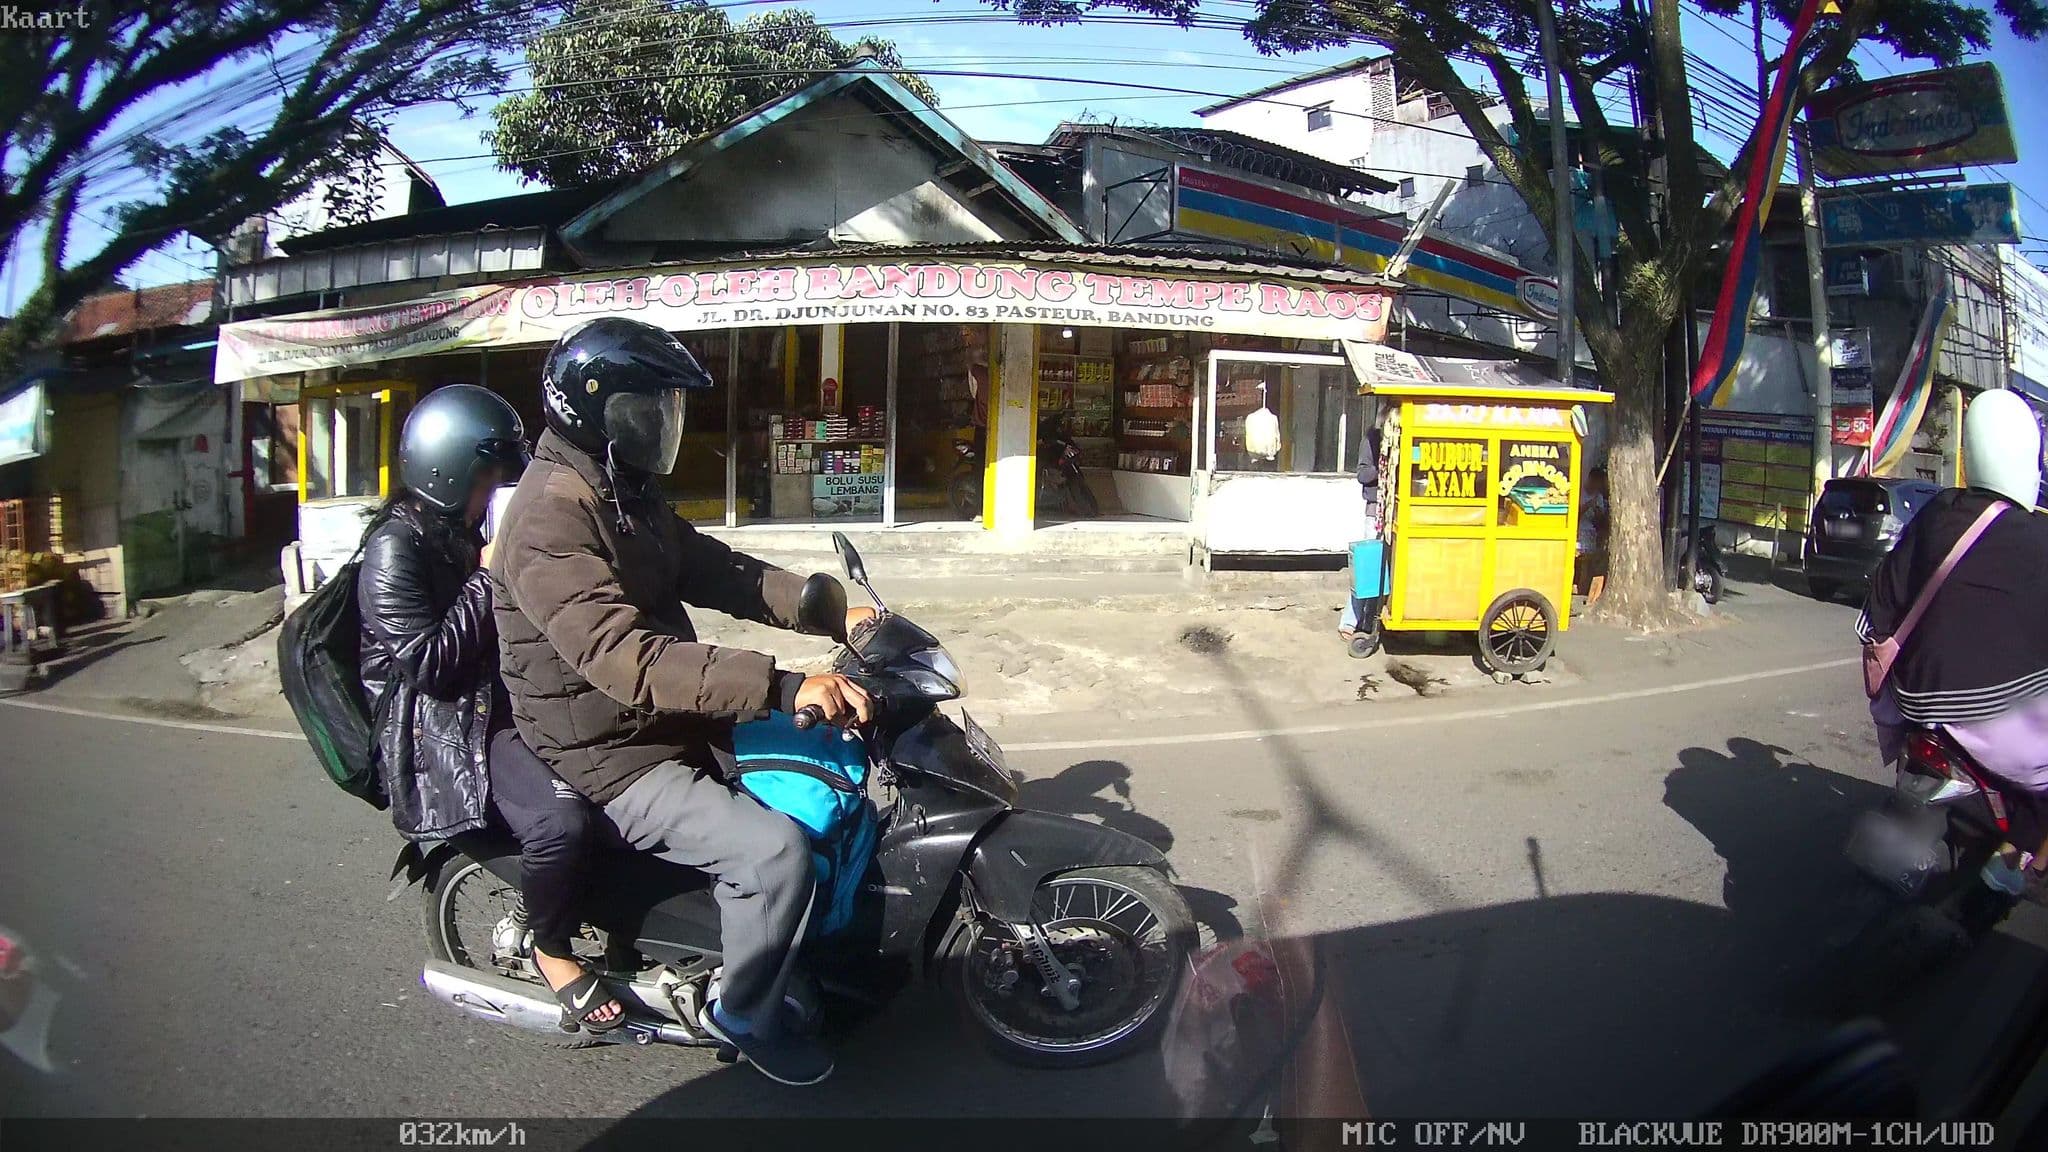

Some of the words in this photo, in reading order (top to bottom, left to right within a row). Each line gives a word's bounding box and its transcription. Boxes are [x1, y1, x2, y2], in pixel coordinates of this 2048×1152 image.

[521, 267, 797, 318] OLEH-OLEH
[804, 264, 1077, 303] BANDUNG
[1083, 273, 1252, 312] TEMPE
[1258, 282, 1384, 321] RAOS
[697, 311, 727, 323] JL.
[734, 308, 769, 322] DR.
[776, 304, 916, 320] DJUNJUNAN
[922, 304, 960, 317] NO.
[965, 304, 989, 319] 83
[995, 304, 1101, 324] PASTEUR,
[1107, 311, 1215, 328] BANDUNG
[1419, 442, 1483, 472] BUBUR
[1509, 444, 1560, 459] ANEKA
[826, 476, 854, 486] BOLU
[858, 475, 885, 485] SUSU
[830, 485, 879, 495] LEMBANG
[1424, 470, 1476, 497] AYAM
